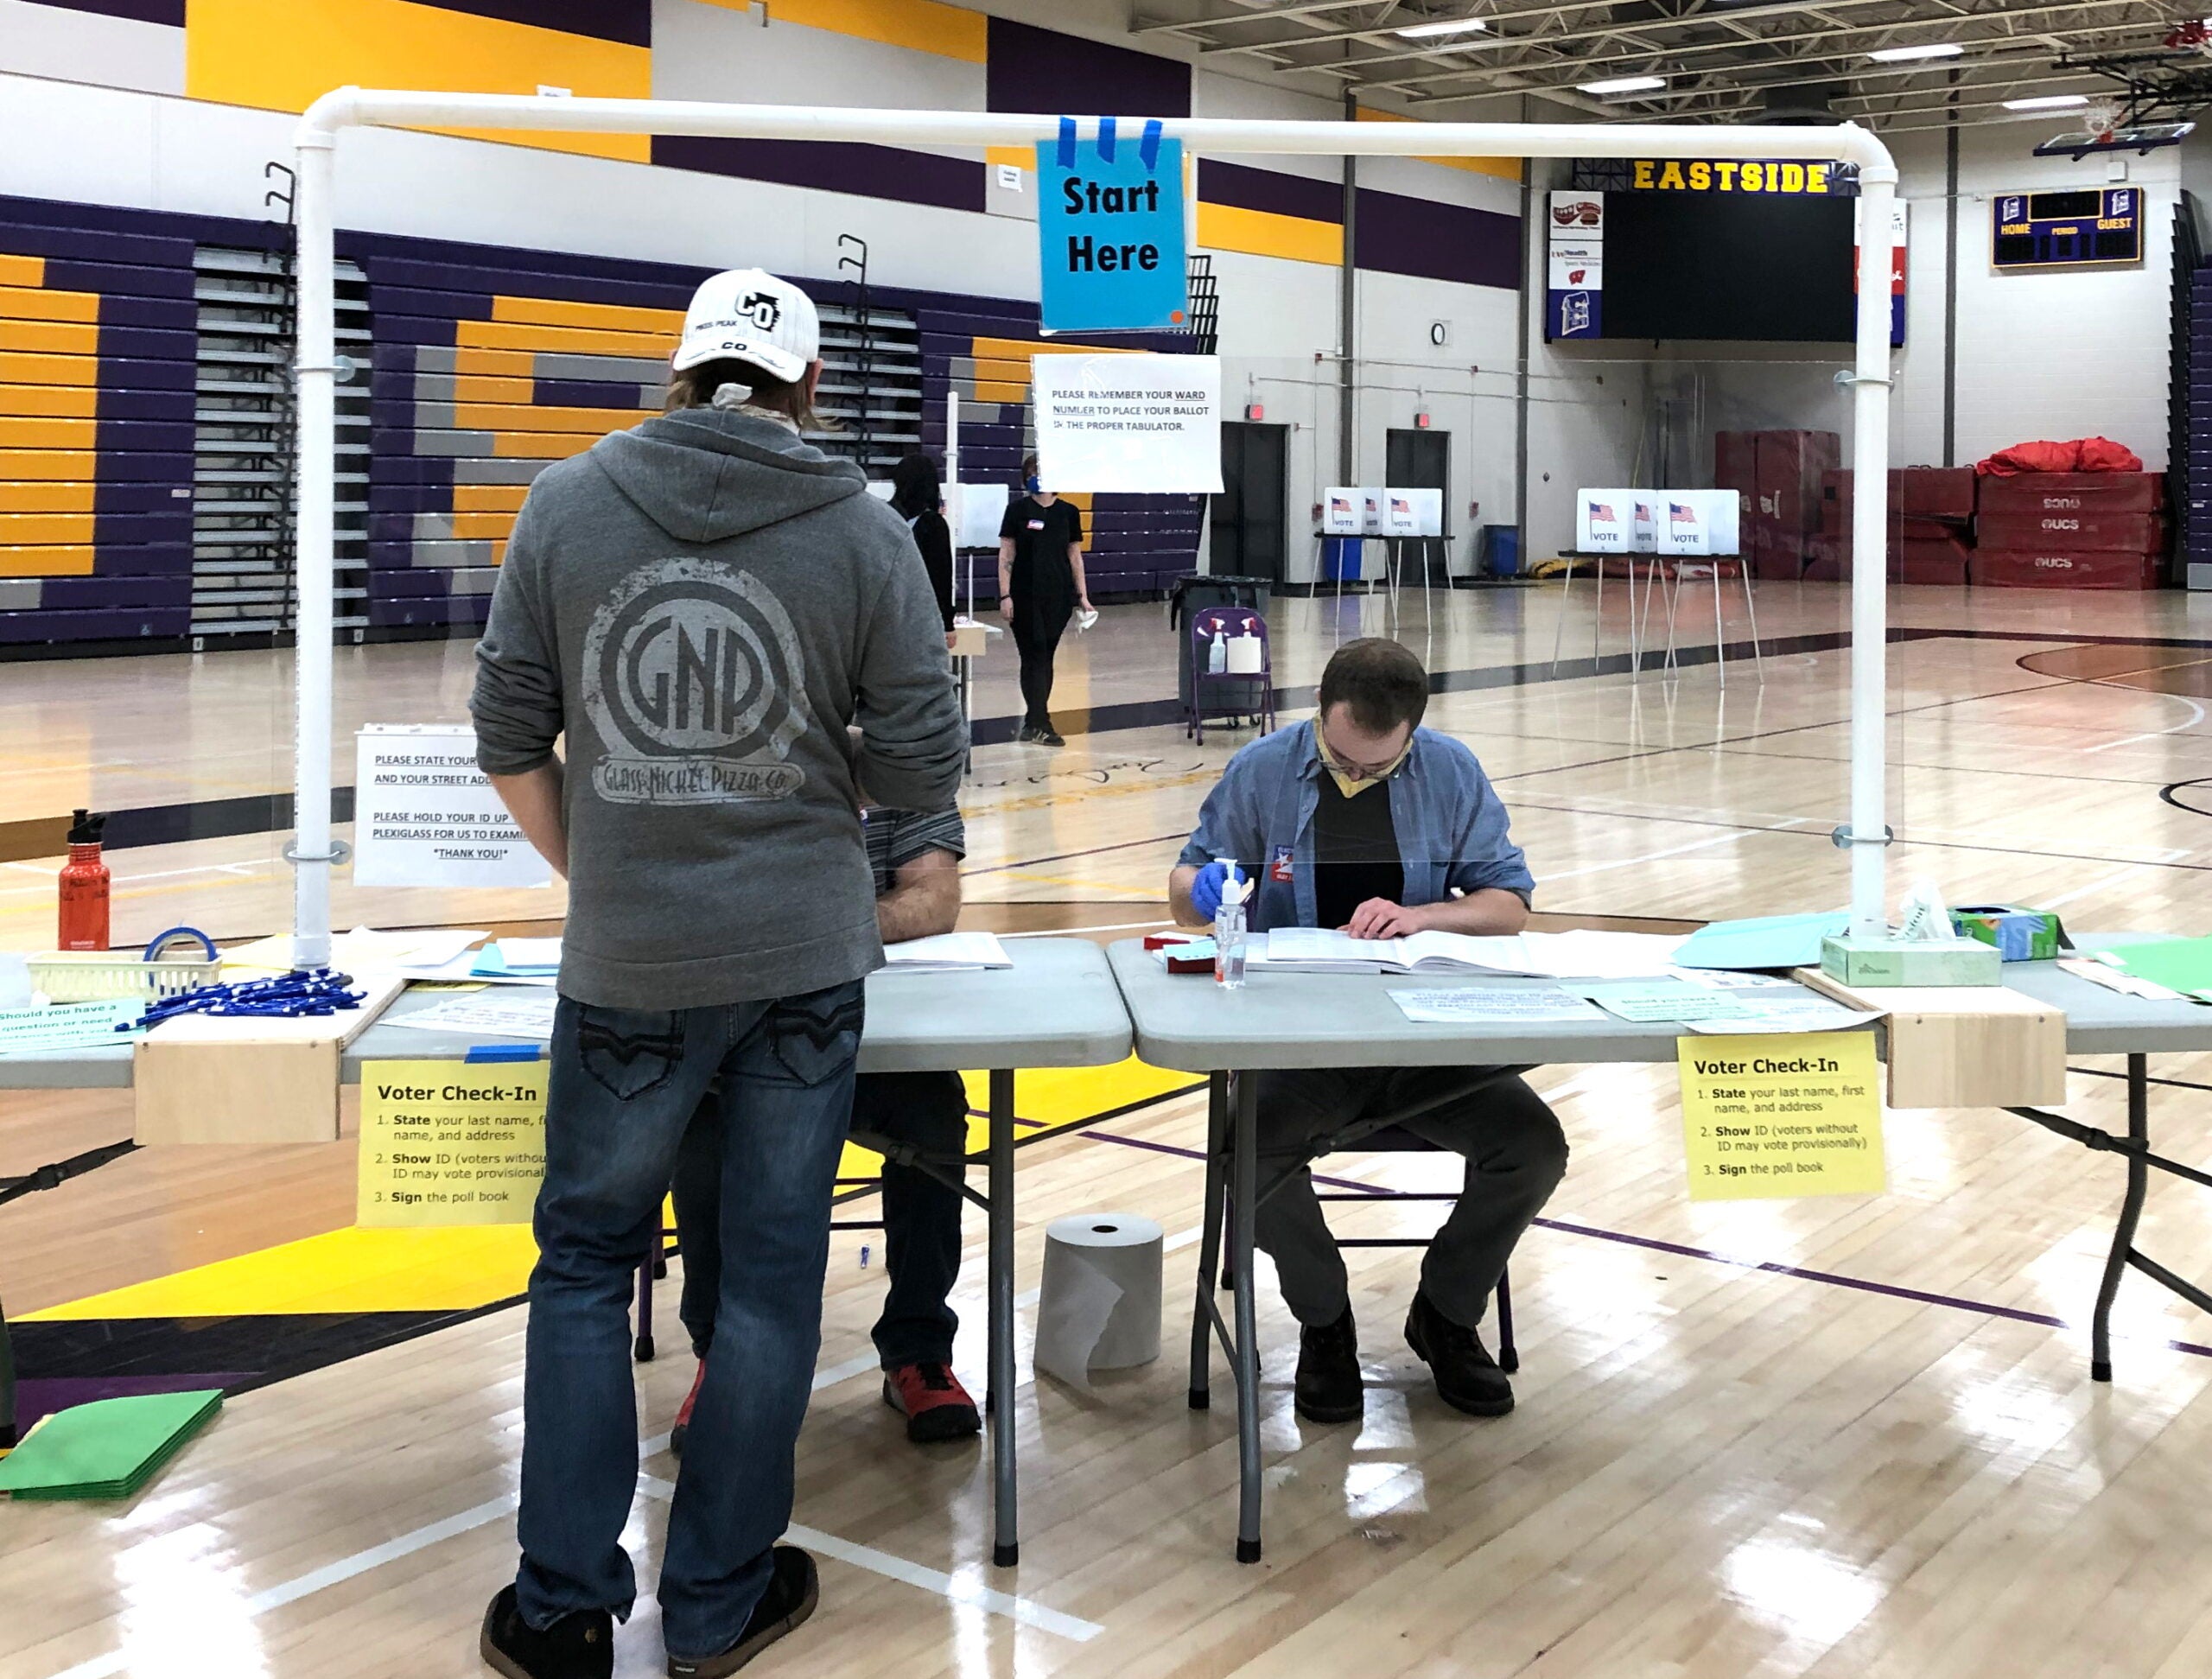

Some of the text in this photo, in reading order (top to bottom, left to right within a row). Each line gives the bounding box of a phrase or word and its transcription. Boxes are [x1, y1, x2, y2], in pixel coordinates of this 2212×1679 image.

[1633, 160, 1830, 194] EASTSIDE
[1063, 176, 1160, 215] Start
[2000, 223, 2031, 235] HOME
[2096, 218, 2133, 230] GUEST
[1068, 235, 1160, 272] Here
[735, 289, 775, 330] CO
[721, 342, 747, 351] CO
[1052, 391, 1206, 400] PLEASE REMEMBER YOUR WARD
[1066, 421, 1084, 429] THE
[1086, 422, 1124, 430] PROPER
[1127, 422, 1185, 431] TABULATOR.
[2051, 519, 2079, 530] UCS
[1673, 534, 1699, 543] VOTE
[2044, 557, 2073, 568] UCS
[626, 615, 764, 735] GNP
[375, 755, 476, 766] PLEASE STATE YOUR
[374, 774, 397, 783] AND
[400, 775, 429, 784] YOUR
[432, 775, 467, 785] STREET
[373, 812, 410, 821] PLEASE
[414, 812, 442, 822] HOLD
[446, 813, 475, 822] YOUR
[494, 814, 509, 823] UP
[372, 829, 431, 838] PLEXIGLASS
[434, 830, 454, 838] FOR
[457, 830, 471, 838] US
[474, 830, 487, 839] TO
[0, 1011, 42, 1020] Should
[47, 1008, 70, 1017] you
[74, 1005, 105, 1014] have
[2, 1022, 60, 1032] question
[1694, 1058, 1840, 1075] Voter Check-In
[378, 1085, 537, 1101] Voter Check-In
[1698, 1084, 1865, 1100] 1. State your last name, first
[1714, 1102, 1823, 1114] name, and address
[377, 1115, 389, 1125] 1.
[393, 1114, 431, 1125] State
[435, 1116, 464, 1127] your
[467, 1115, 492, 1125] last
[494, 1116, 535, 1127] name,
[393, 1130, 516, 1142] name, and address
[1700, 1123, 1859, 1138] 2. Show ID (voters without
[1718, 1136, 1867, 1153] ID may vote provisionally)
[375, 1153, 547, 1166] 2. Show ID (voters withou
[392, 1167, 546, 1181] ID may vote provisional
[1704, 1161, 1824, 1177] 3. Sign the poll book
[374, 1191, 510, 1205] 3. Sign the poll book
